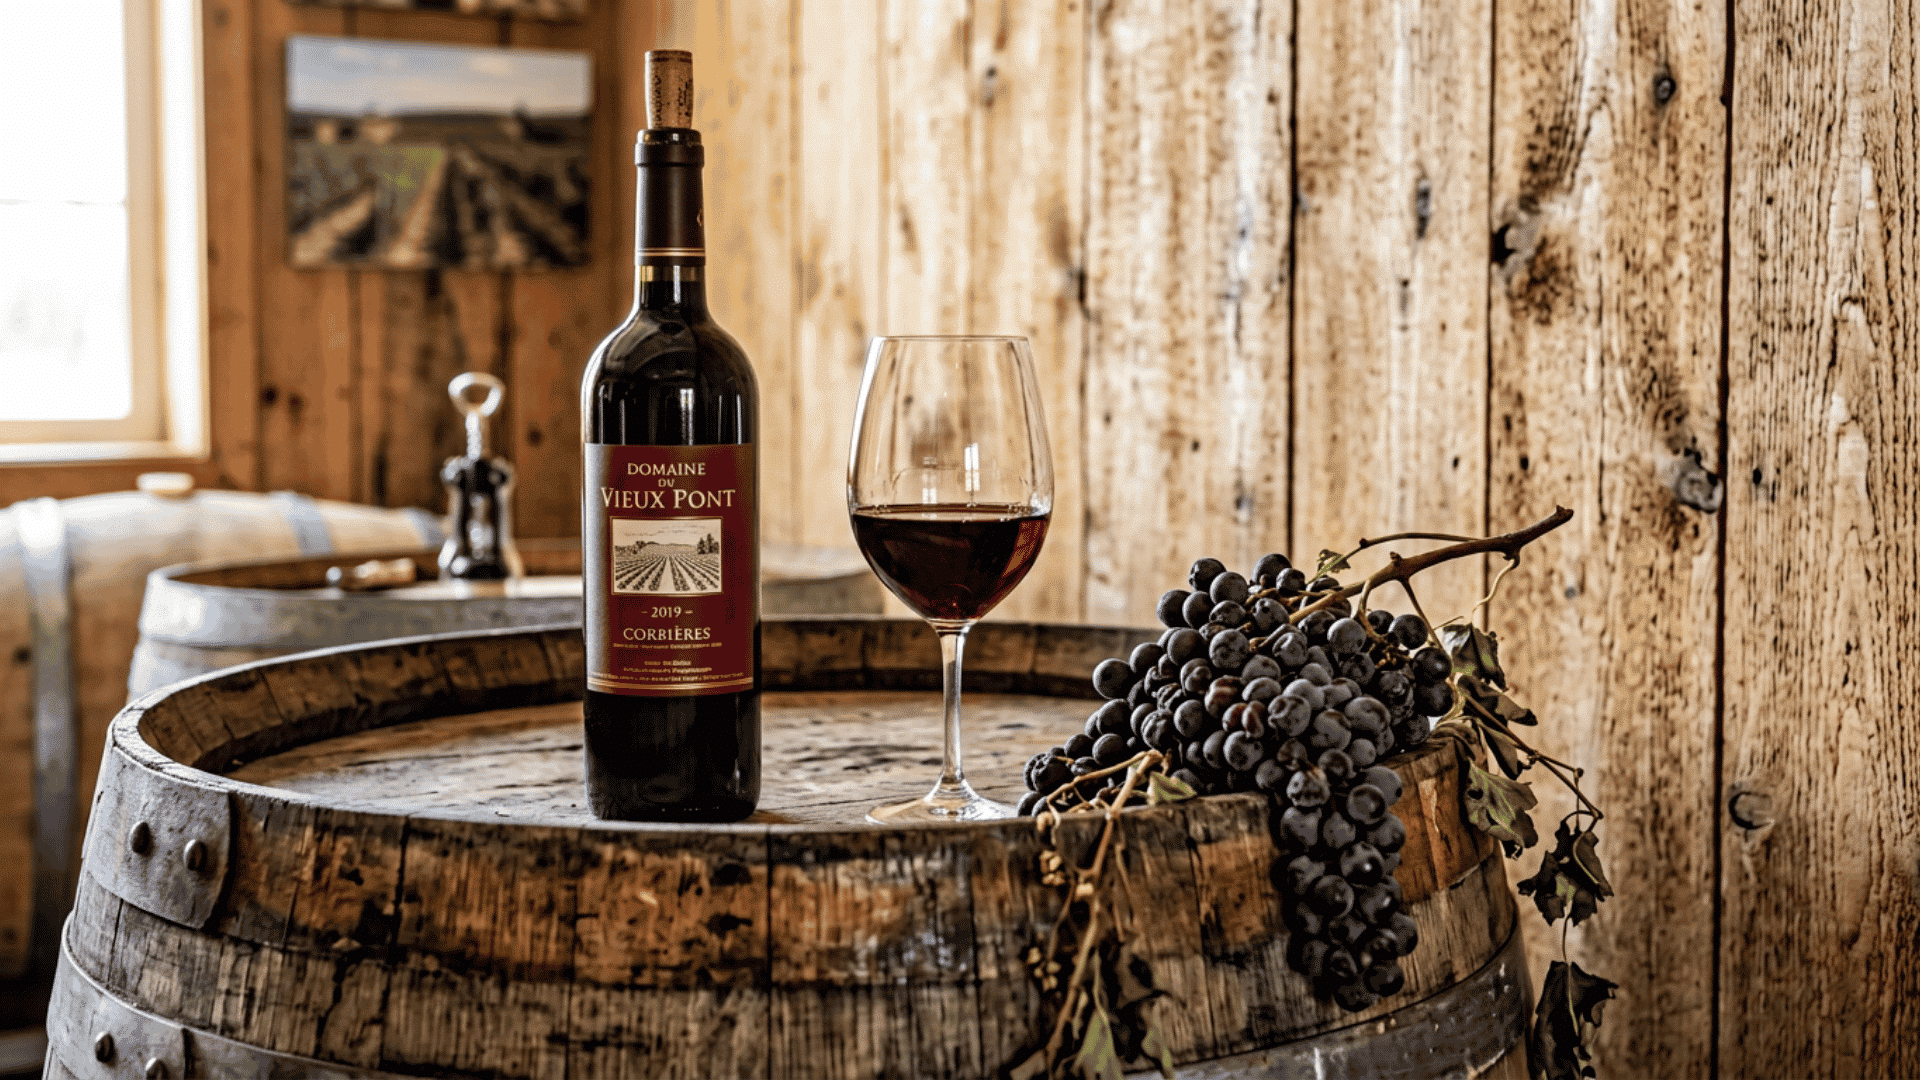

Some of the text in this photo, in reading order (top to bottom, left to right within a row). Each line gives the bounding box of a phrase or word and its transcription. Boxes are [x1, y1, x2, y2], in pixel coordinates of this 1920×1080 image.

[627, 462, 707, 476] DOMAINE
[600, 486, 736, 509] VIEUX PONT
[651, 606, 682, 618] 2019
[623, 625, 711, 641] CORBIÈRES
